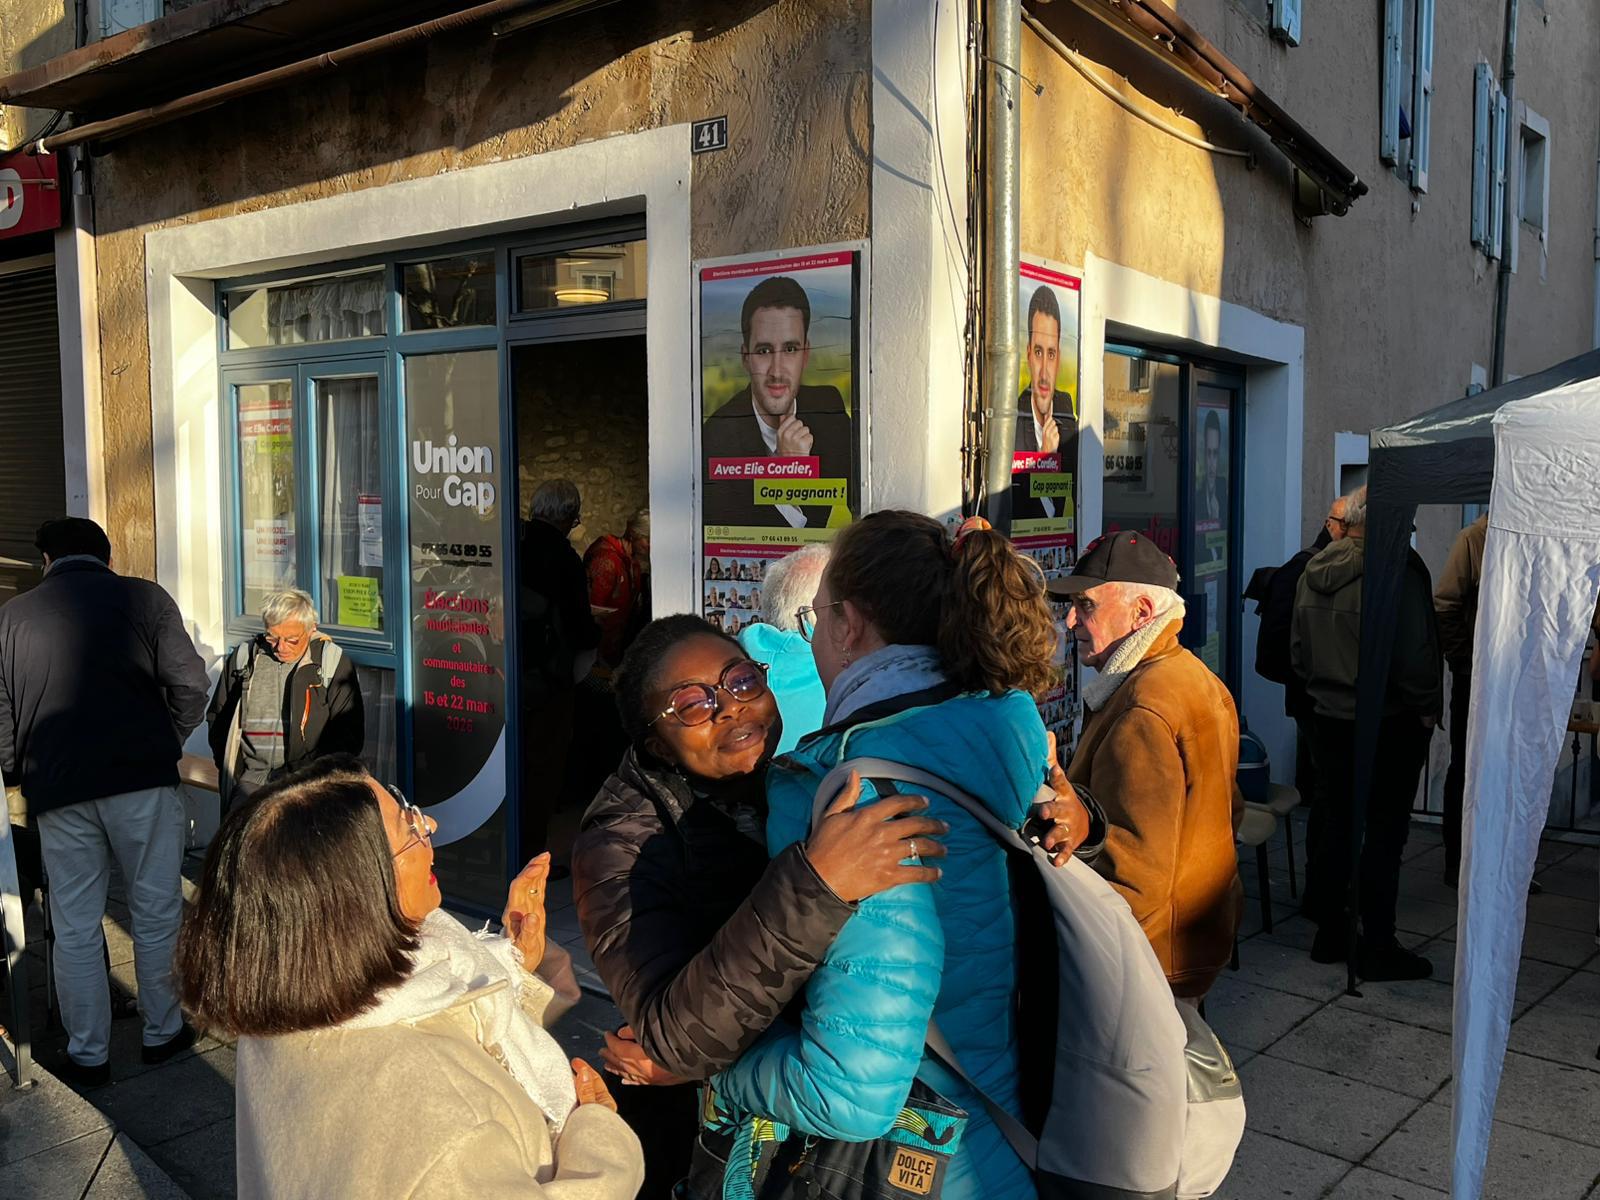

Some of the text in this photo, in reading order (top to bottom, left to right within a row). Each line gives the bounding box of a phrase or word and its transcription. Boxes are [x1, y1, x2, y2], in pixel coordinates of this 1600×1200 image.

[699, 123, 720, 147] 41
[413, 435, 492, 474] Union
[1105, 455, 1115, 470] 66
[1115, 455, 1124, 470] 43
[714, 460, 813, 477] Avec Elie Cordier,
[1025, 456, 1036, 469] Elie
[1036, 457, 1059, 471] Cordier,
[415, 475, 495, 514] Pour Gap
[760, 486, 845, 501] Gap gagnant !
[1032, 479, 1044, 492] Gap
[1045, 481, 1068, 494] gagnant
[449, 544, 462, 556] 43
[464, 544, 477, 557] 89
[479, 545, 492, 557] 55
[426, 619, 490, 635] municipales
[452, 642, 461, 653] et
[423, 657, 495, 675] communautaires
[450, 674, 466, 688] des
[423, 691, 434, 705] 15
[437, 694, 449, 708] et
[450, 694, 464, 710] 22
[896, 1153, 934, 1176] DOLCE
[899, 1169, 924, 1189] VITA
